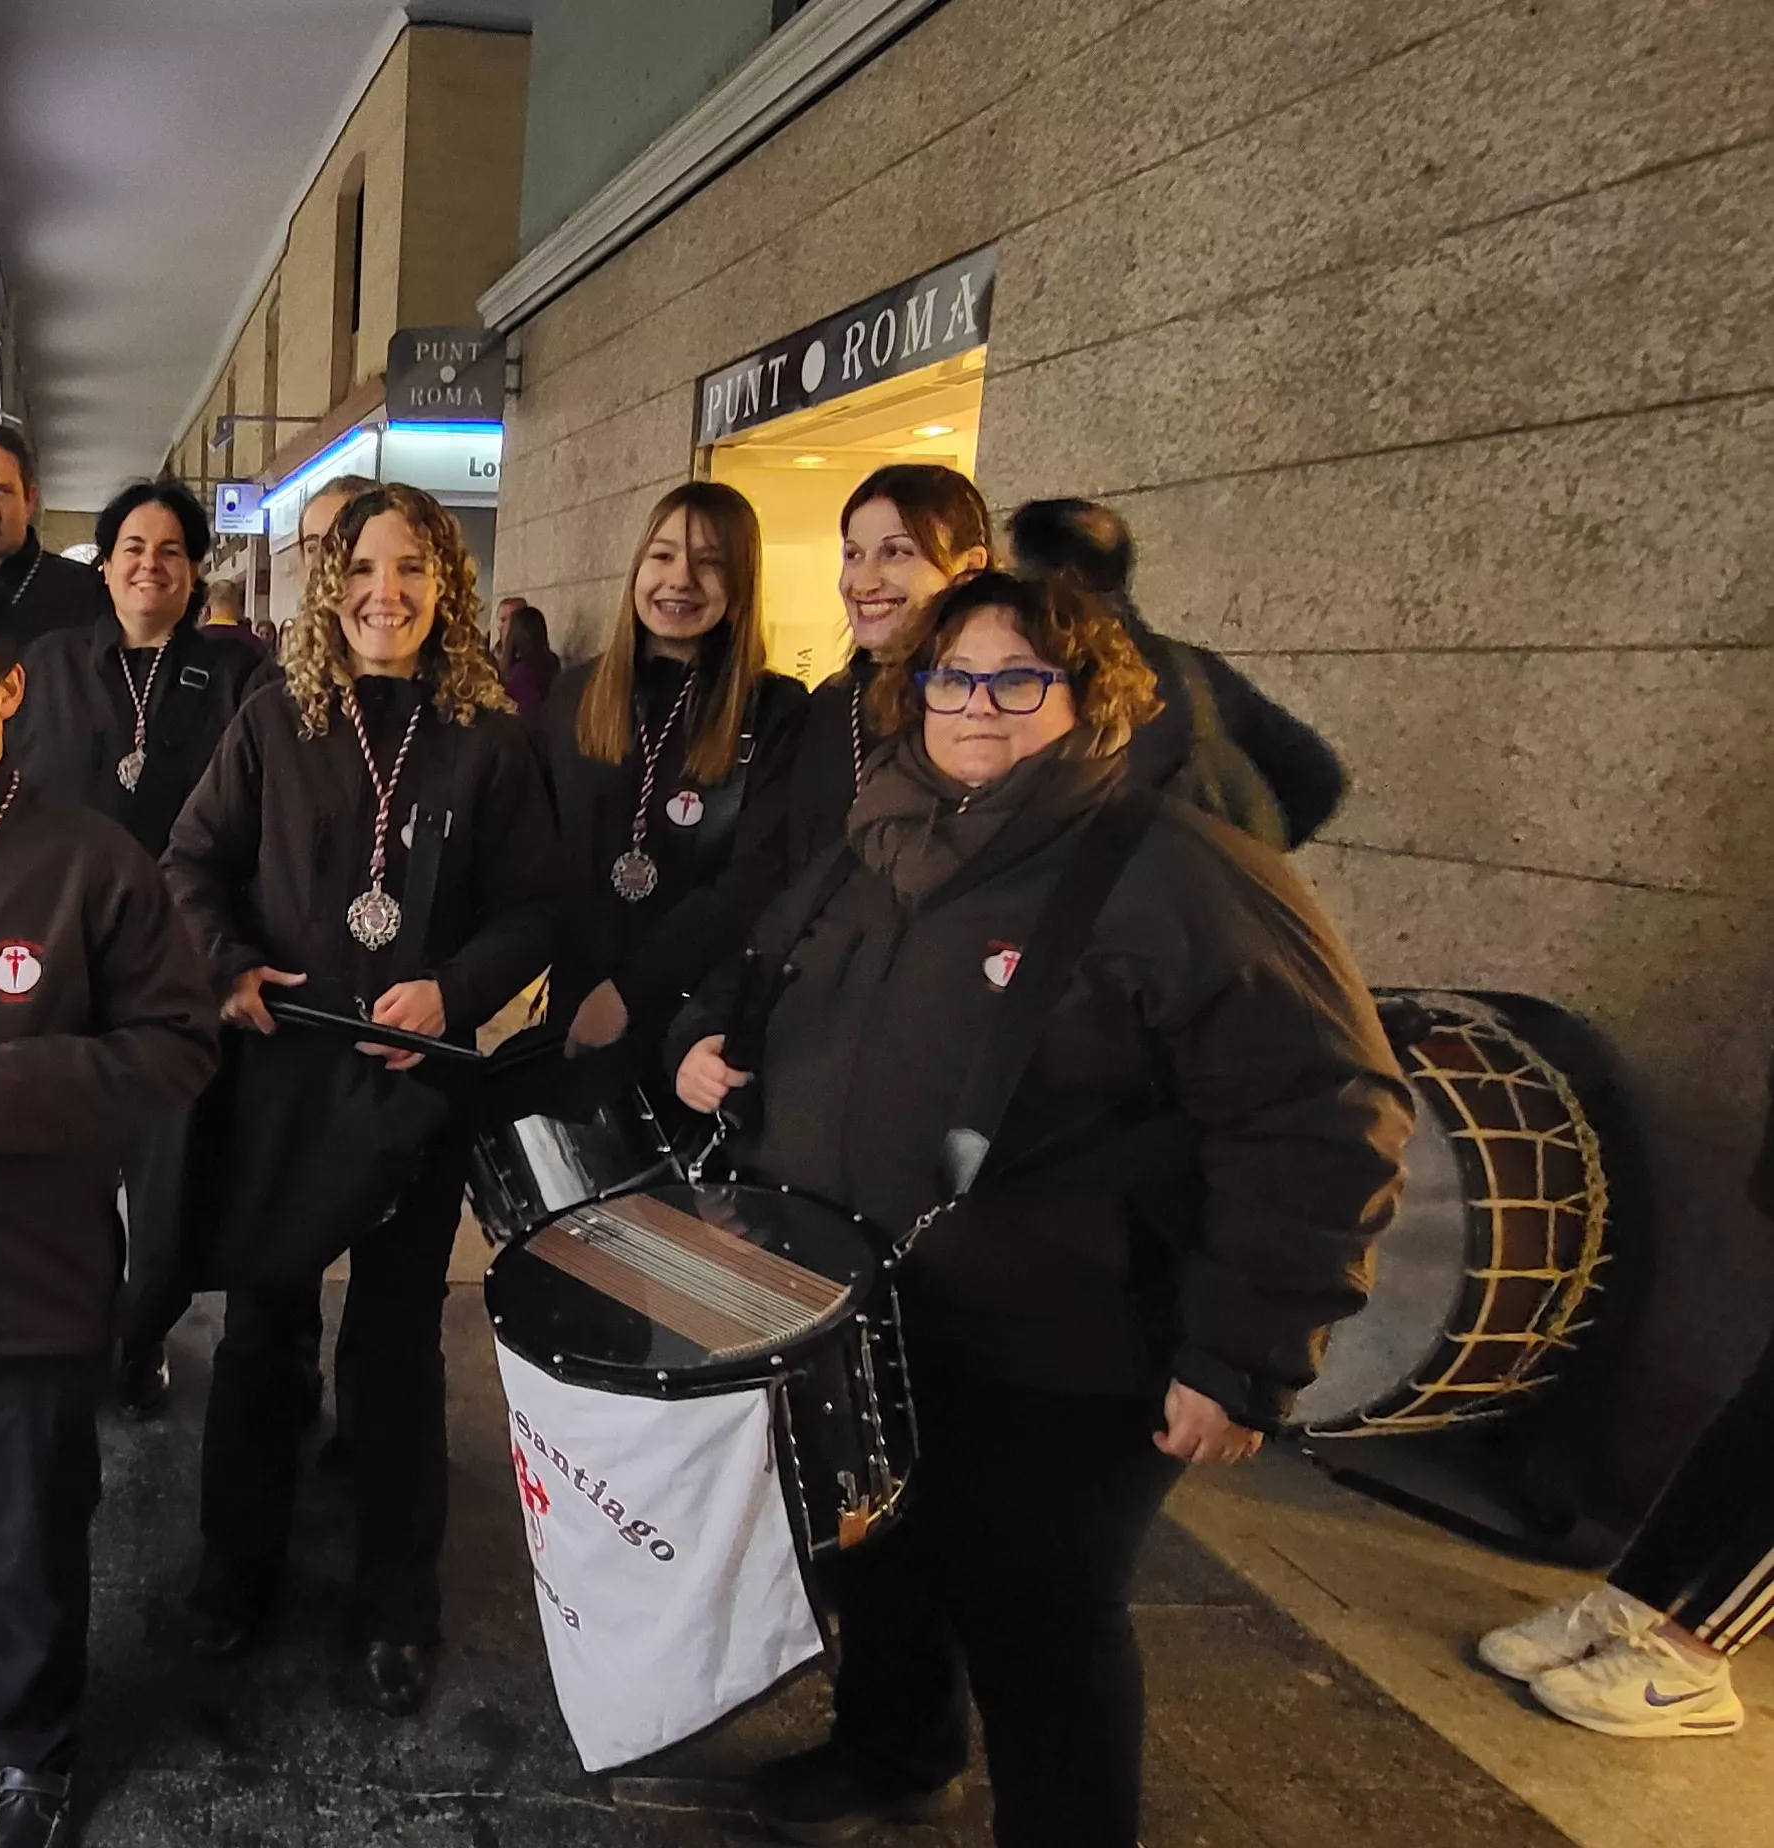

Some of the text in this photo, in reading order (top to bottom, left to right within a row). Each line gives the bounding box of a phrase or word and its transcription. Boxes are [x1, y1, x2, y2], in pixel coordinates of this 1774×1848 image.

[416, 342, 483, 362] PUNT
[706, 272, 978, 432] PUNT ROMA
[410, 387, 483, 407] ROMA
[469, 456, 501, 478] Lo
[514, 1409, 676, 1562] Santiago
